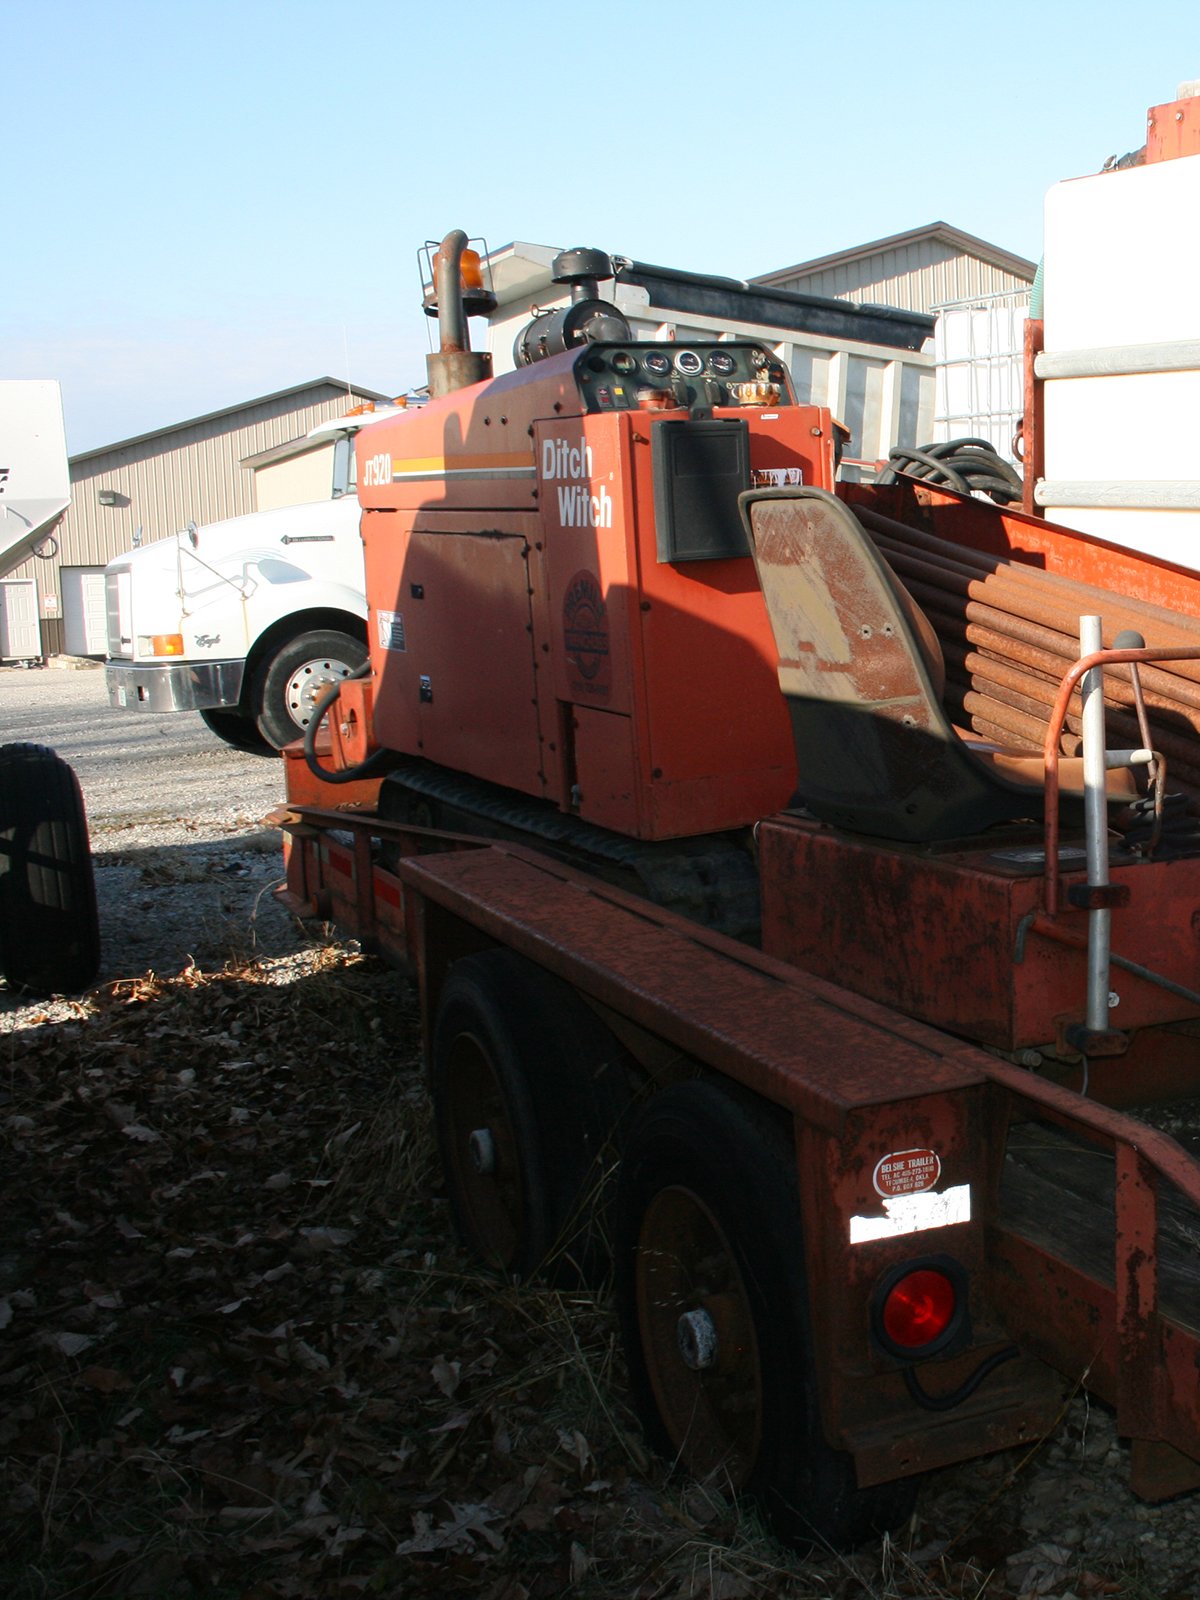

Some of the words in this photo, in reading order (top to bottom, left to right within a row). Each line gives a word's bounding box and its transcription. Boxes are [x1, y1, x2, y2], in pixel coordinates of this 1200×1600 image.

[363, 453, 391, 486] JT920
[542, 438, 592, 480] Ditch
[557, 485, 612, 528] Witch
[881, 1161, 905, 1173] BELSHE
[908, 1157, 934, 1168] TRAILER
